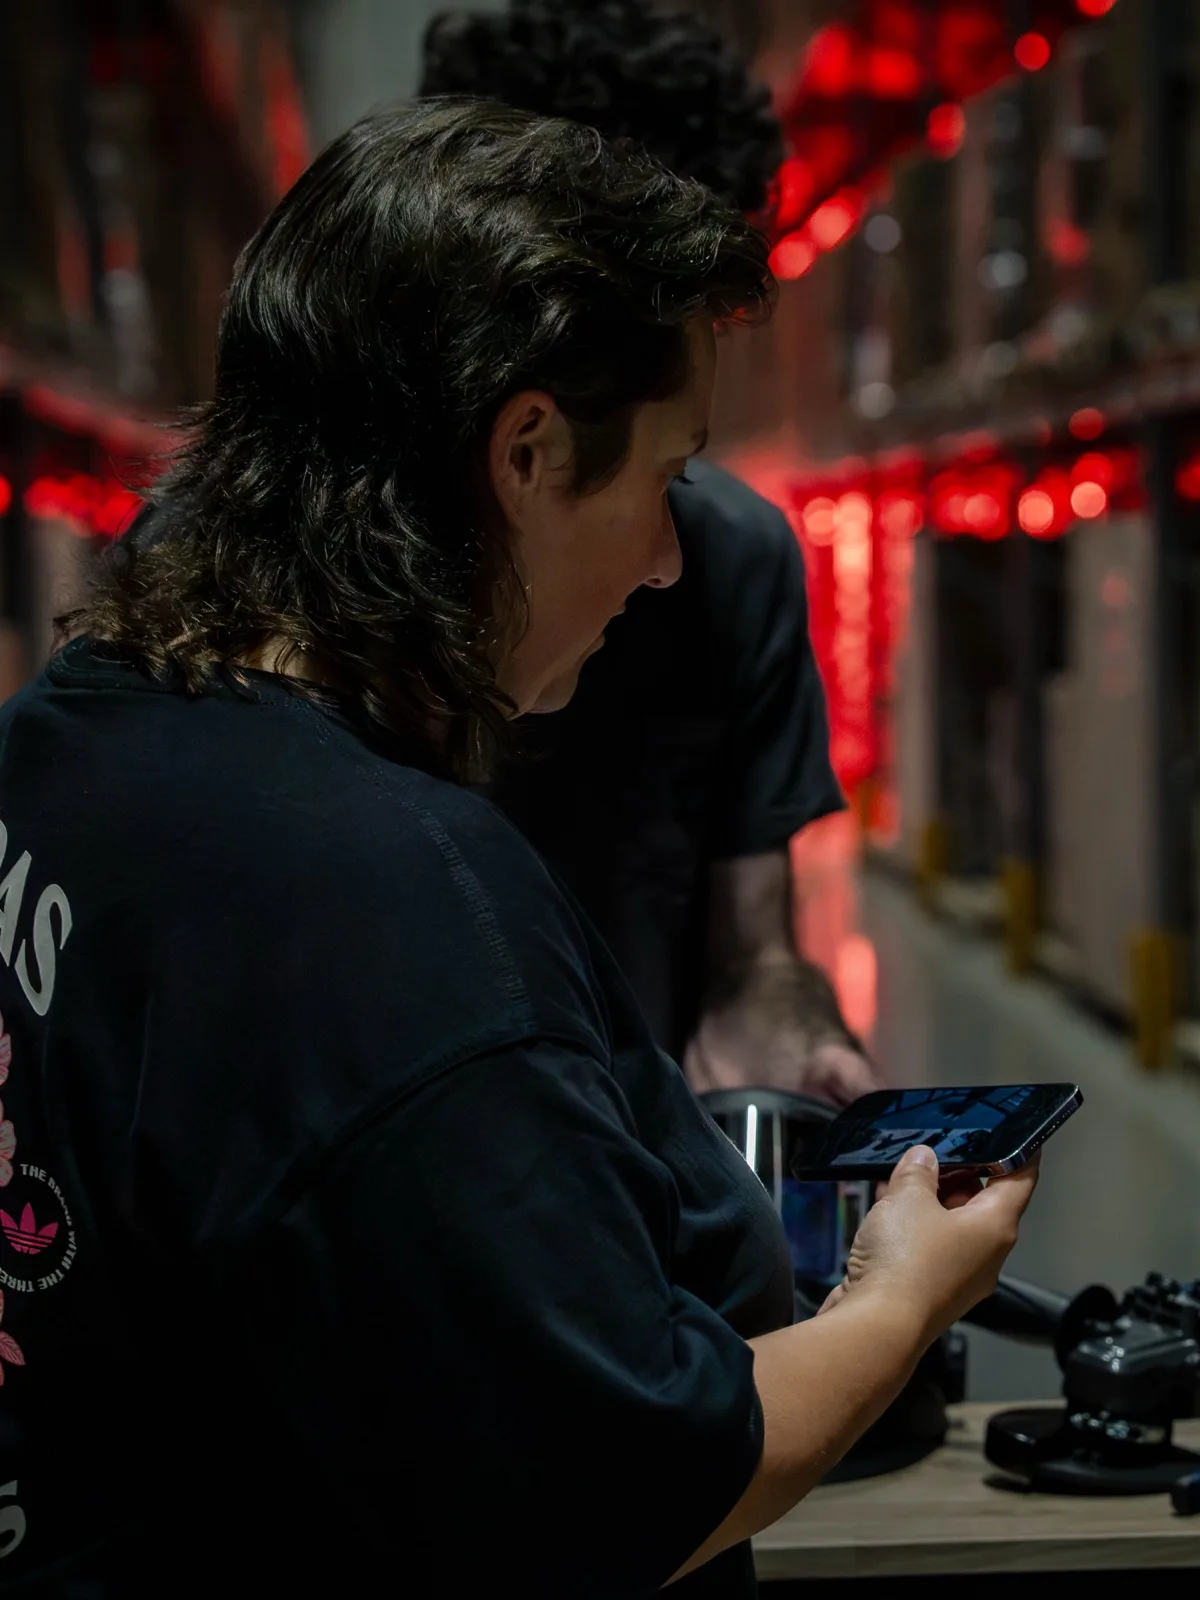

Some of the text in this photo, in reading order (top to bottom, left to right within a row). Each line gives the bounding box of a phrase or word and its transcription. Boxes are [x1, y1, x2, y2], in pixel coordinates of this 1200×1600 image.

[20, 1163, 48, 1182] THE
[61, 1230, 77, 1271] WITH
[0, 1265, 35, 1292] THRE
[37, 1268, 65, 1290] THE
